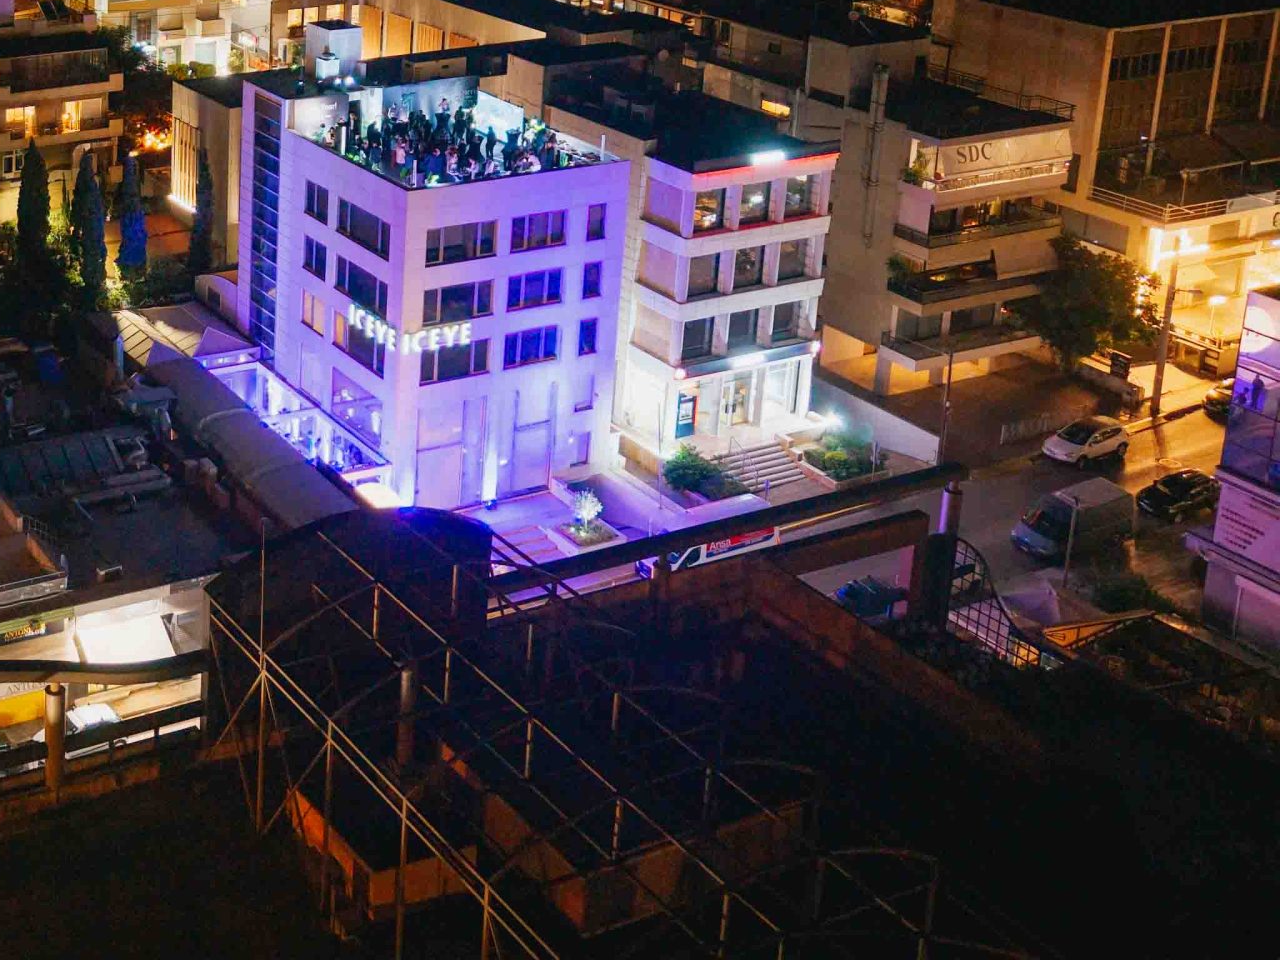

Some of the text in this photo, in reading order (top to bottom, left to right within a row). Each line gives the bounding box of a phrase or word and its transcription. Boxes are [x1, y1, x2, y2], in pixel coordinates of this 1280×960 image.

[955, 142, 993, 164] SDC
[348, 303, 397, 352] ICEYE
[401, 322, 472, 355] ICEYE
